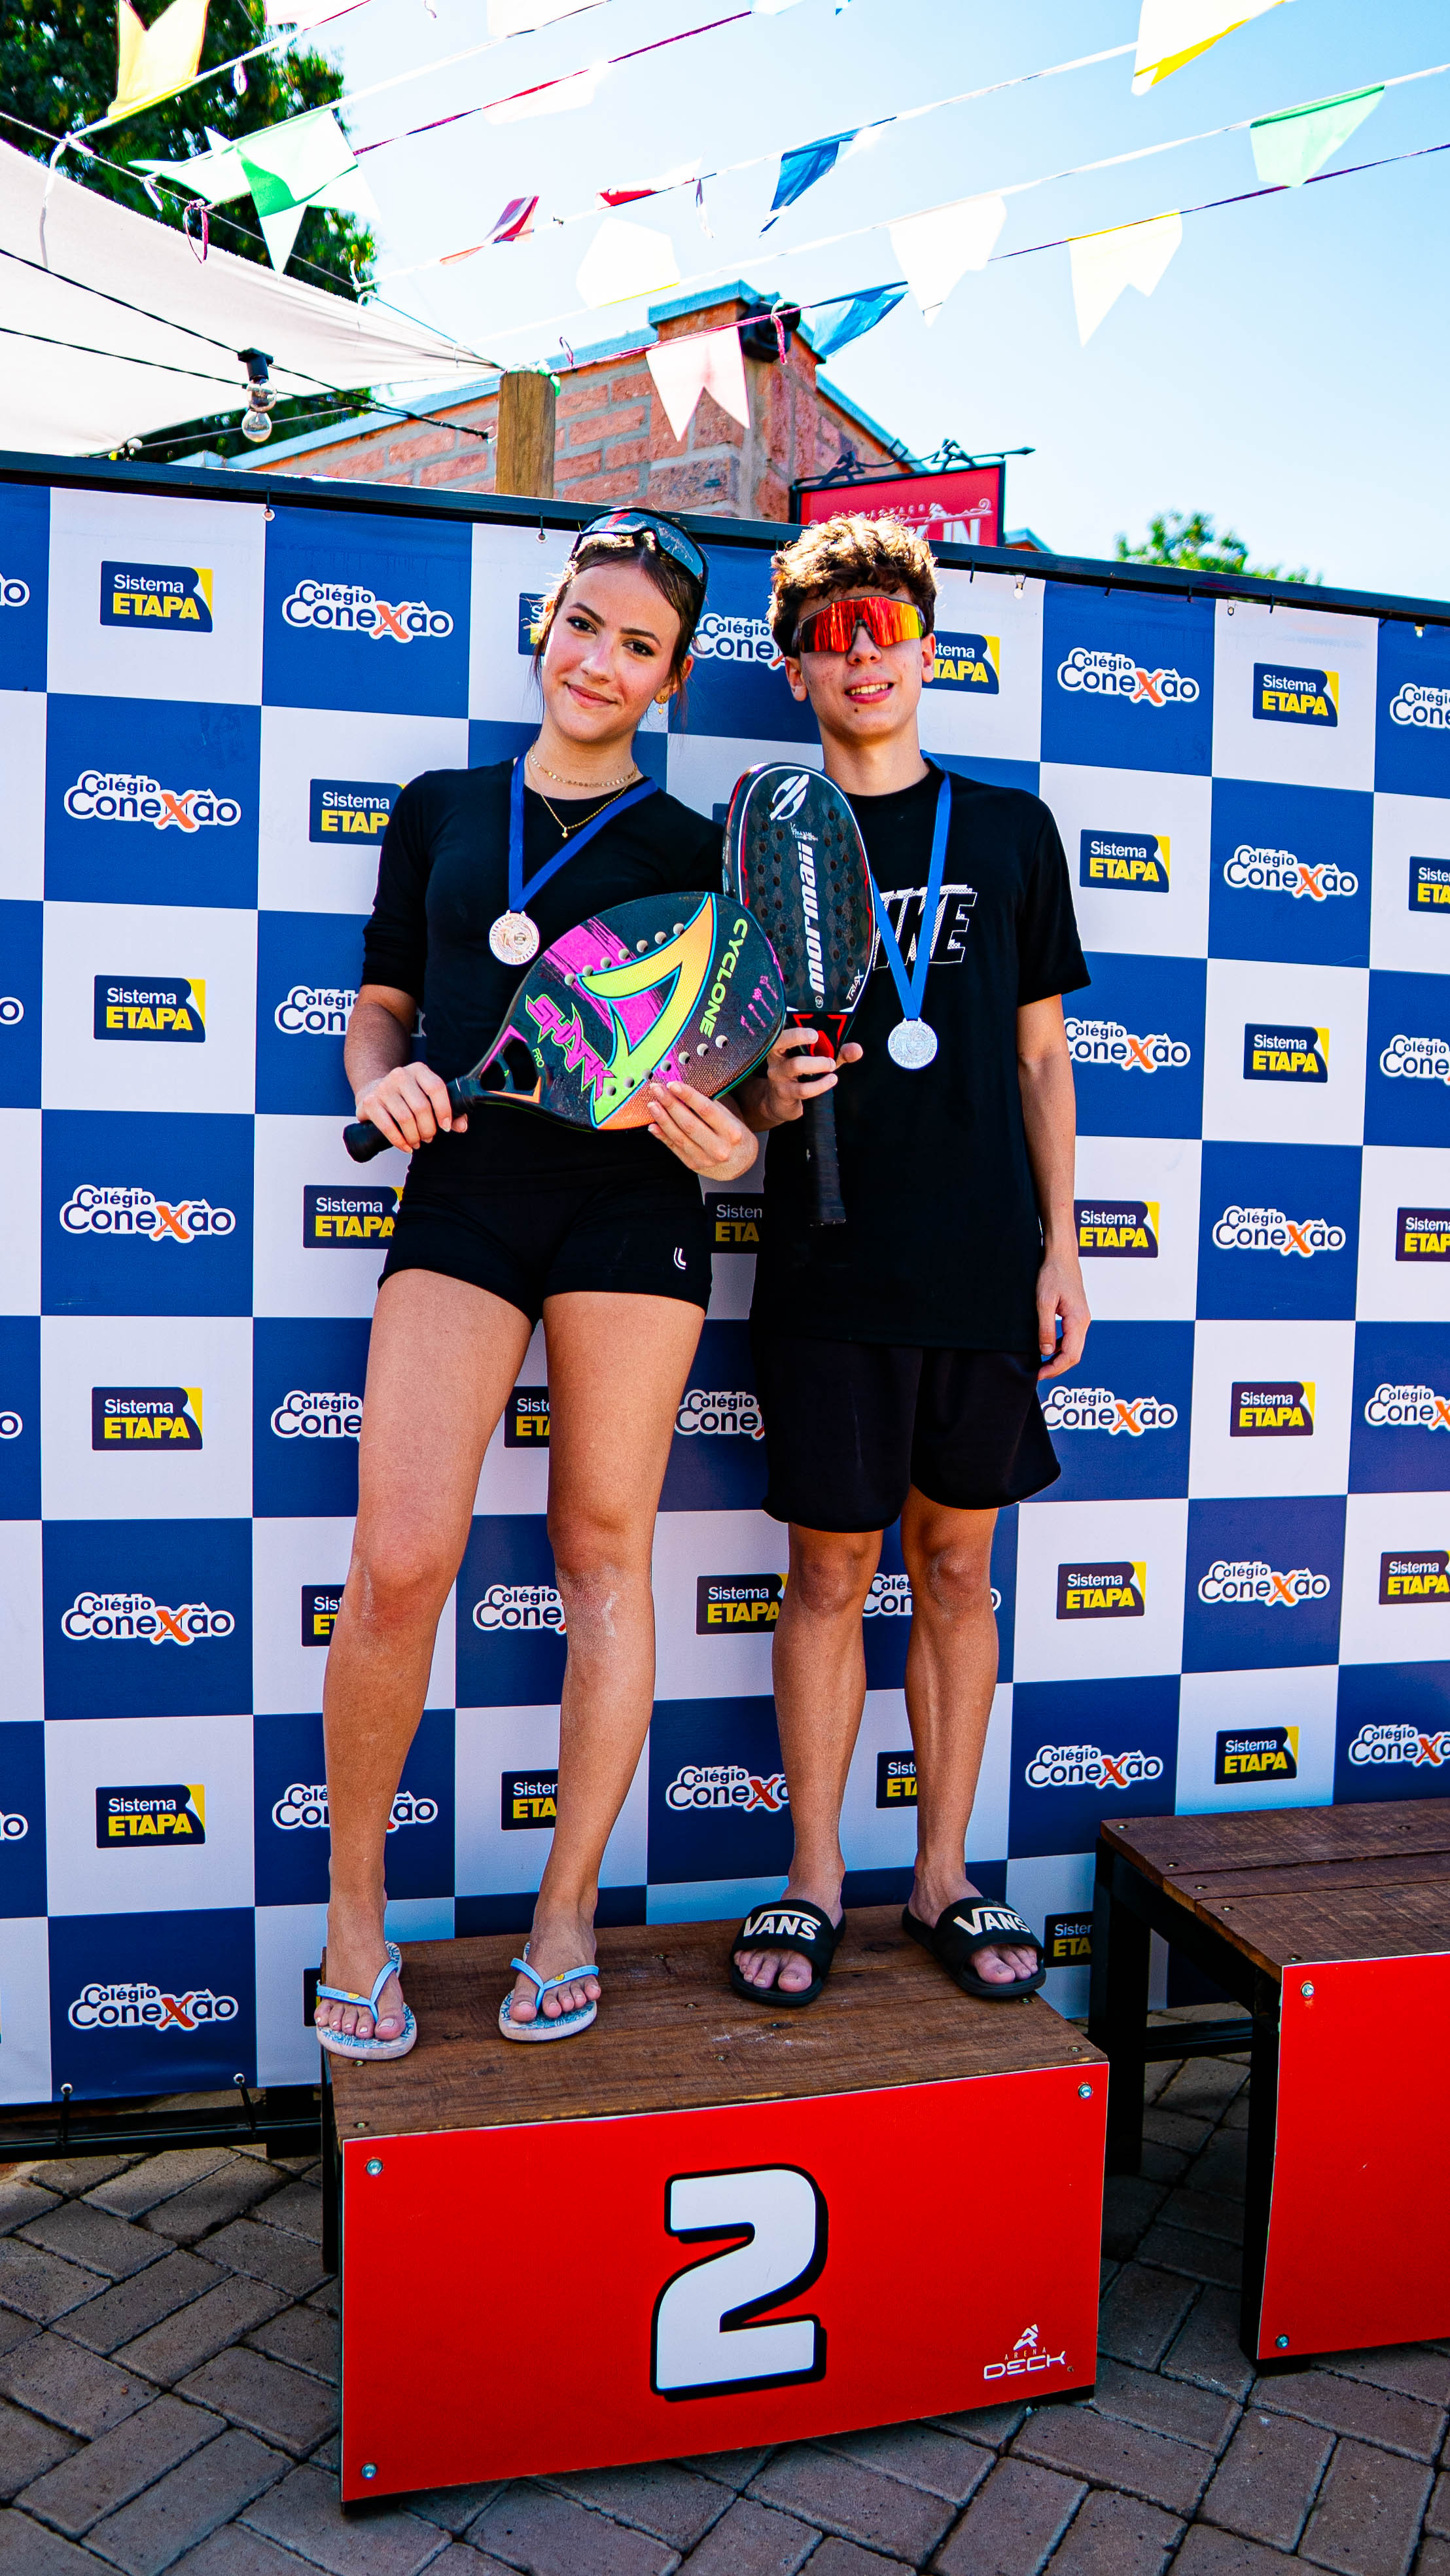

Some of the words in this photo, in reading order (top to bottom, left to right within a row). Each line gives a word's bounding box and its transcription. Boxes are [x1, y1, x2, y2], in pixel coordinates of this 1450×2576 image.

[114, 574, 183, 593] Sistema
[299, 582, 371, 605] Colégio
[113, 592, 200, 620] ETAPA
[703, 617, 769, 637] Colégio
[696, 633, 784, 667] Cone
[934, 643, 975, 659] tema
[934, 658, 989, 683] TAPA
[1072, 651, 1132, 670] Colégio
[1263, 675, 1317, 692] Sistema
[1262, 690, 1328, 717] ETAPA
[1403, 687, 1450, 706] Colégi
[82, 773, 156, 796] Colégio
[322, 792, 389, 810] Sistema
[321, 810, 390, 833] ETAP
[1091, 841, 1146, 859] Sistema
[1237, 848, 1294, 867] Colégio
[1089, 858, 1159, 882] ETAPA
[1418, 867, 1450, 882] Siste
[1417, 883, 1450, 903] ETA
[798, 842, 825, 994] mormaii
[699, 918, 748, 1038] CYCLONE
[107, 987, 176, 1005] Sistema
[106, 1007, 193, 1031] ETAPA
[1065, 1020, 1123, 1039] Colégio
[1254, 1033, 1307, 1050] Sistema
[1393, 1037, 1446, 1054] Colégio
[533, 1048, 545, 1068] PRO
[1253, 1050, 1318, 1073] ETAPA
[1383, 1047, 1450, 1080] Cone
[77, 1187, 151, 1208] Colégio
[315, 1197, 382, 1213] Sistema
[315, 1216, 395, 1238] ETAPA
[1080, 1211, 1137, 1226] Sistema
[1226, 1209, 1282, 1227] Colégio
[715, 1221, 760, 1242] ETA
[1080, 1226, 1148, 1248] ETAPA
[1404, 1234, 1450, 1253] ETAP
[287, 1393, 359, 1414] Colégio
[687, 1392, 754, 1412] Colégio
[1052, 1389, 1112, 1407] Colégio
[1241, 1392, 1293, 1406] Sistema
[1379, 1386, 1431, 1404] Colégio
[105, 1399, 173, 1414] Sistema
[1239, 1406, 1304, 1427] ETAPA
[105, 1417, 190, 1439] ETAPA
[275, 1406, 361, 1435] Cone
[675, 1406, 764, 1437] Cone
[1213, 1563, 1267, 1581] Colégio
[1388, 1561, 1439, 1574] Sistema
[1068, 1573, 1122, 1587] Sistema
[1387, 1575, 1450, 1595] ETAPA
[486, 1586, 557, 1607] Colégio
[708, 1586, 769, 1600] Sistema
[1066, 1588, 1135, 1609] ETAPA
[78, 1594, 151, 1616] Colégio
[708, 1602, 779, 1622] ETAPA
[476, 1600, 566, 1631] Cone
[1362, 1727, 1415, 1744] Colégio
[1226, 1739, 1277, 1753] Sistema
[1039, 1747, 1098, 1766] Colégio
[1224, 1752, 1287, 1774] ETAPA
[681, 1768, 745, 1788] Colégio
[288, 1786, 327, 1806] Colé
[513, 1782, 557, 1796] Siste
[108, 1797, 176, 1813] Sistema
[513, 1798, 557, 1819] ETA
[108, 1814, 193, 1836] ETAPA
[744, 1909, 821, 1940] VANS
[953, 1907, 1031, 1937] VANS
[1054, 1923, 1091, 1936] Siste
[1053, 1938, 1091, 1957] ETA
[84, 1986, 156, 2005] Colégio
[650, 2164, 828, 2402] 2
[1004, 2347, 1046, 2361] ARENA
[984, 2351, 1065, 2380] DECK
